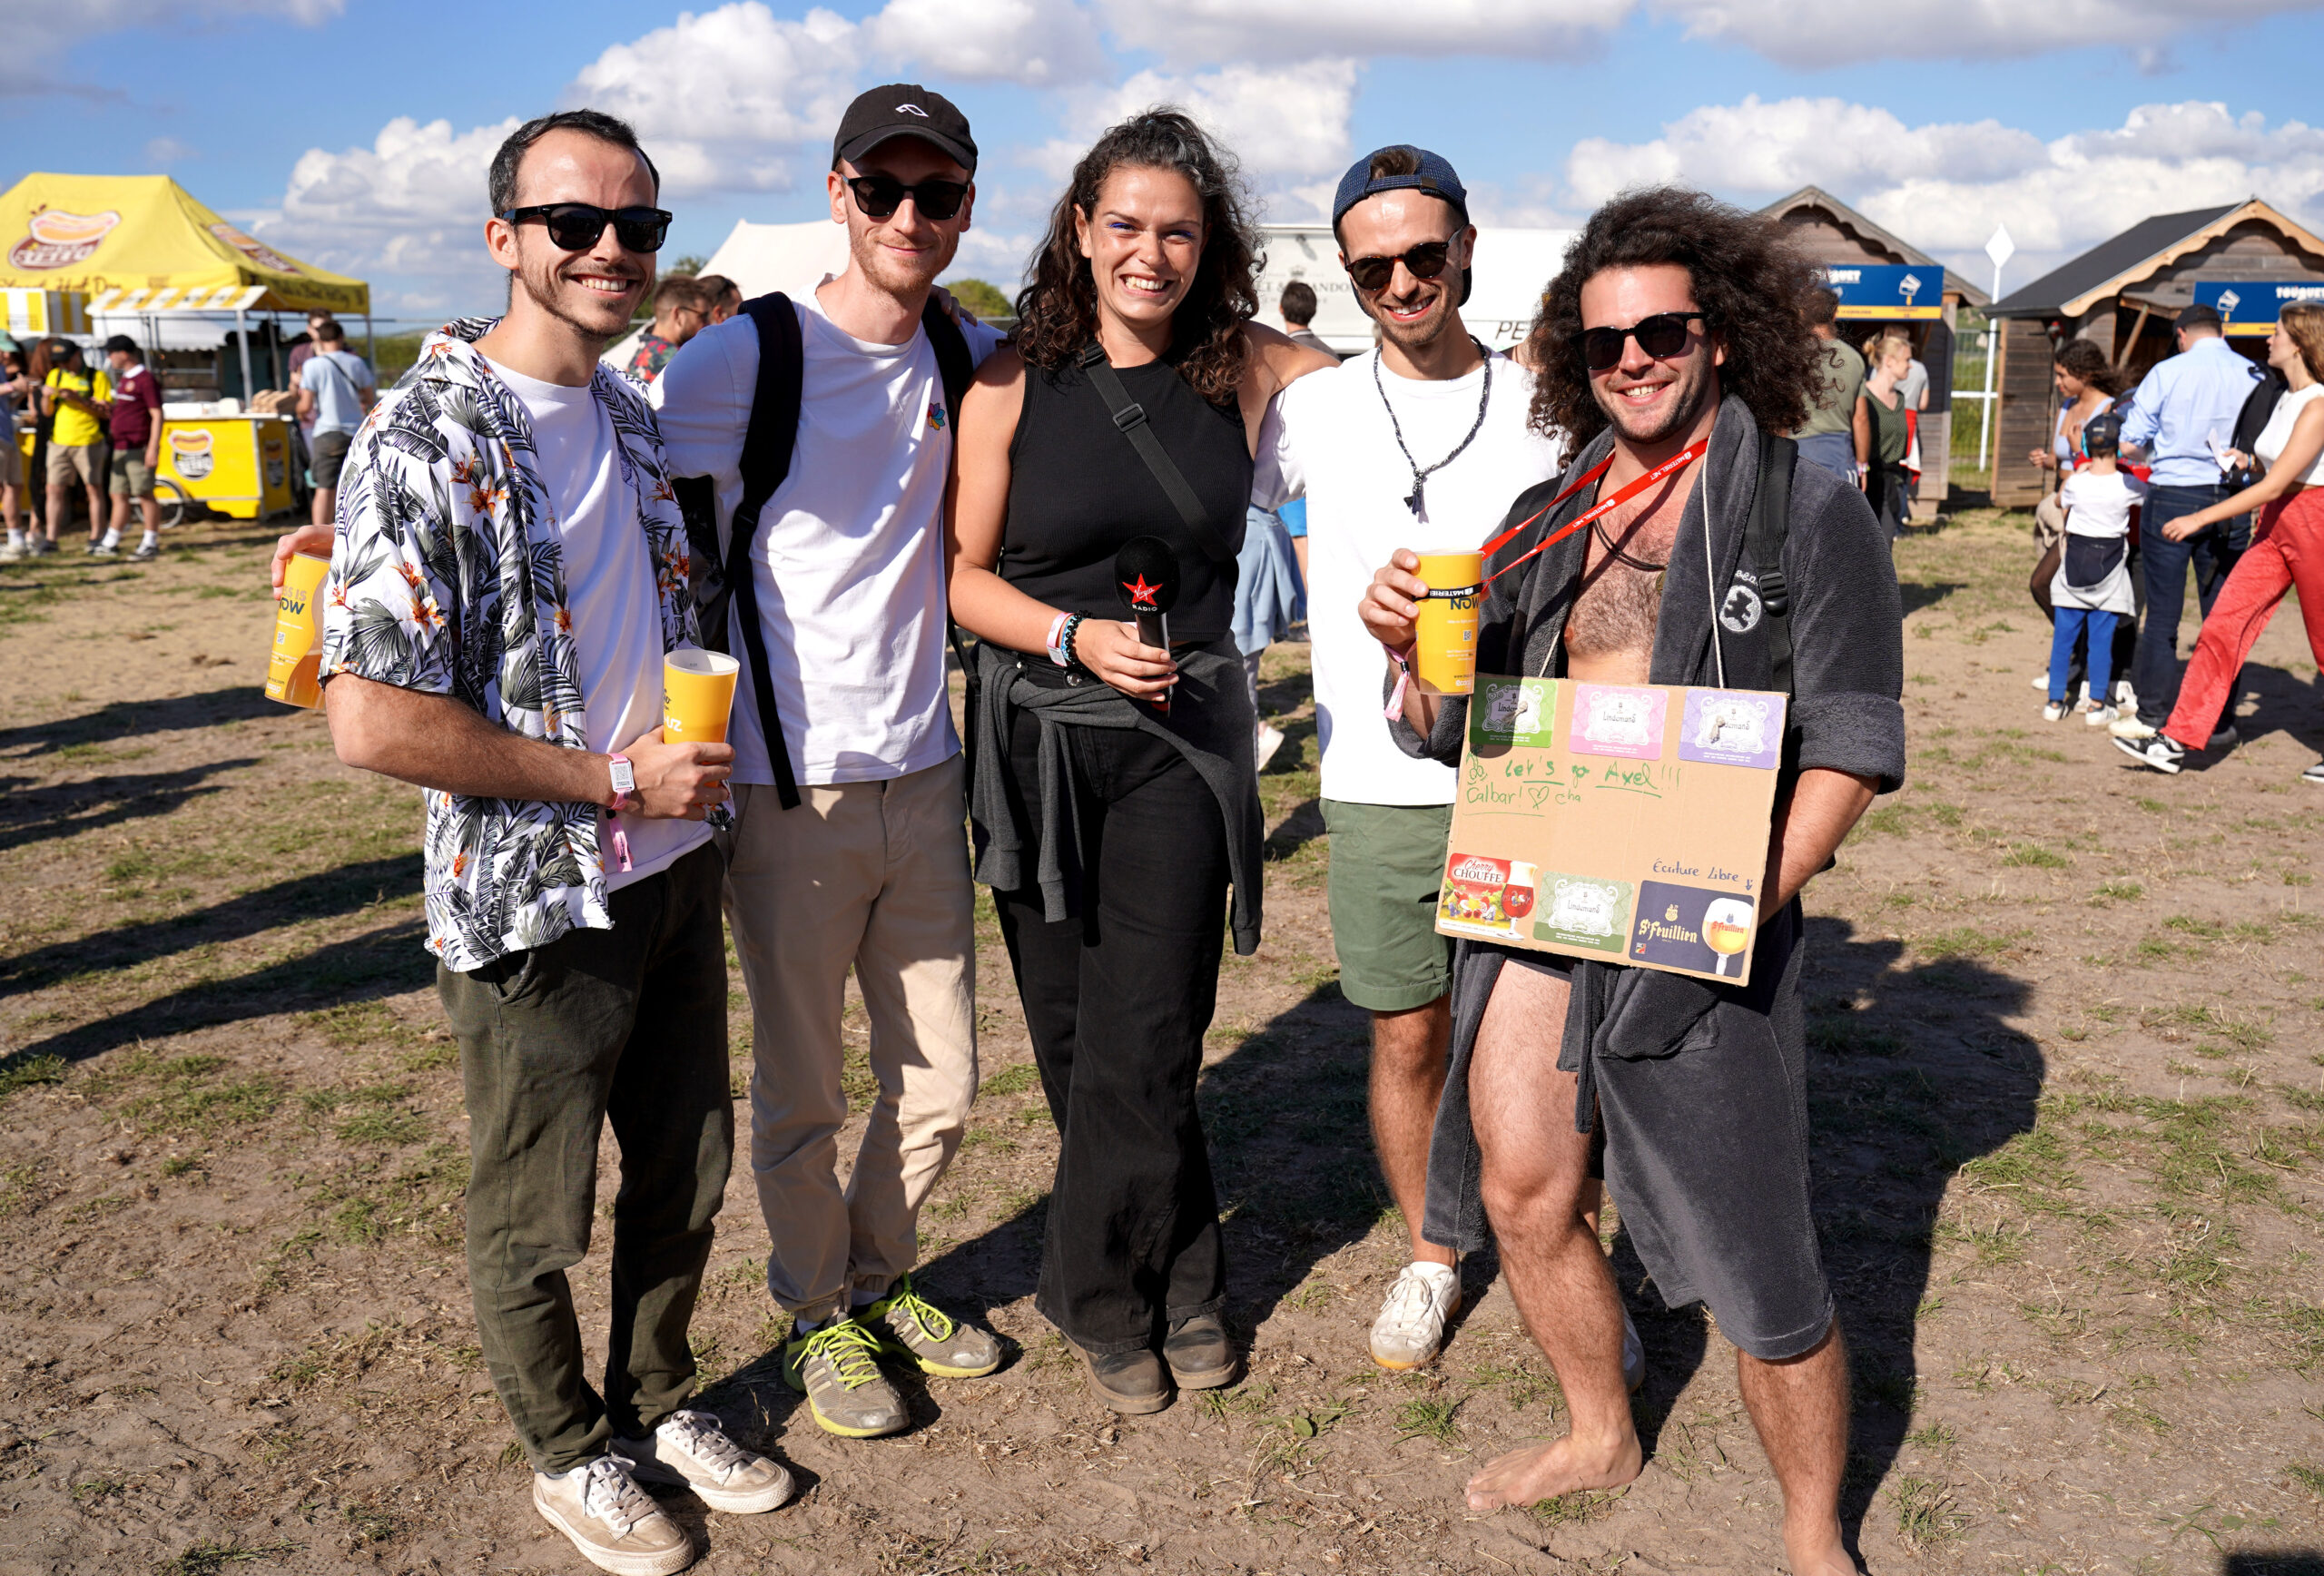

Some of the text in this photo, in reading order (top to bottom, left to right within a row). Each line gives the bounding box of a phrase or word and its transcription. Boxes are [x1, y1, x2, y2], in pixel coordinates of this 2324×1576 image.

[1134, 584, 1155, 600] Virgin
[1463, 859, 1494, 872] Cherry
[1453, 868, 1502, 883] CHOUFFE
[1707, 866, 1739, 882] Libre
